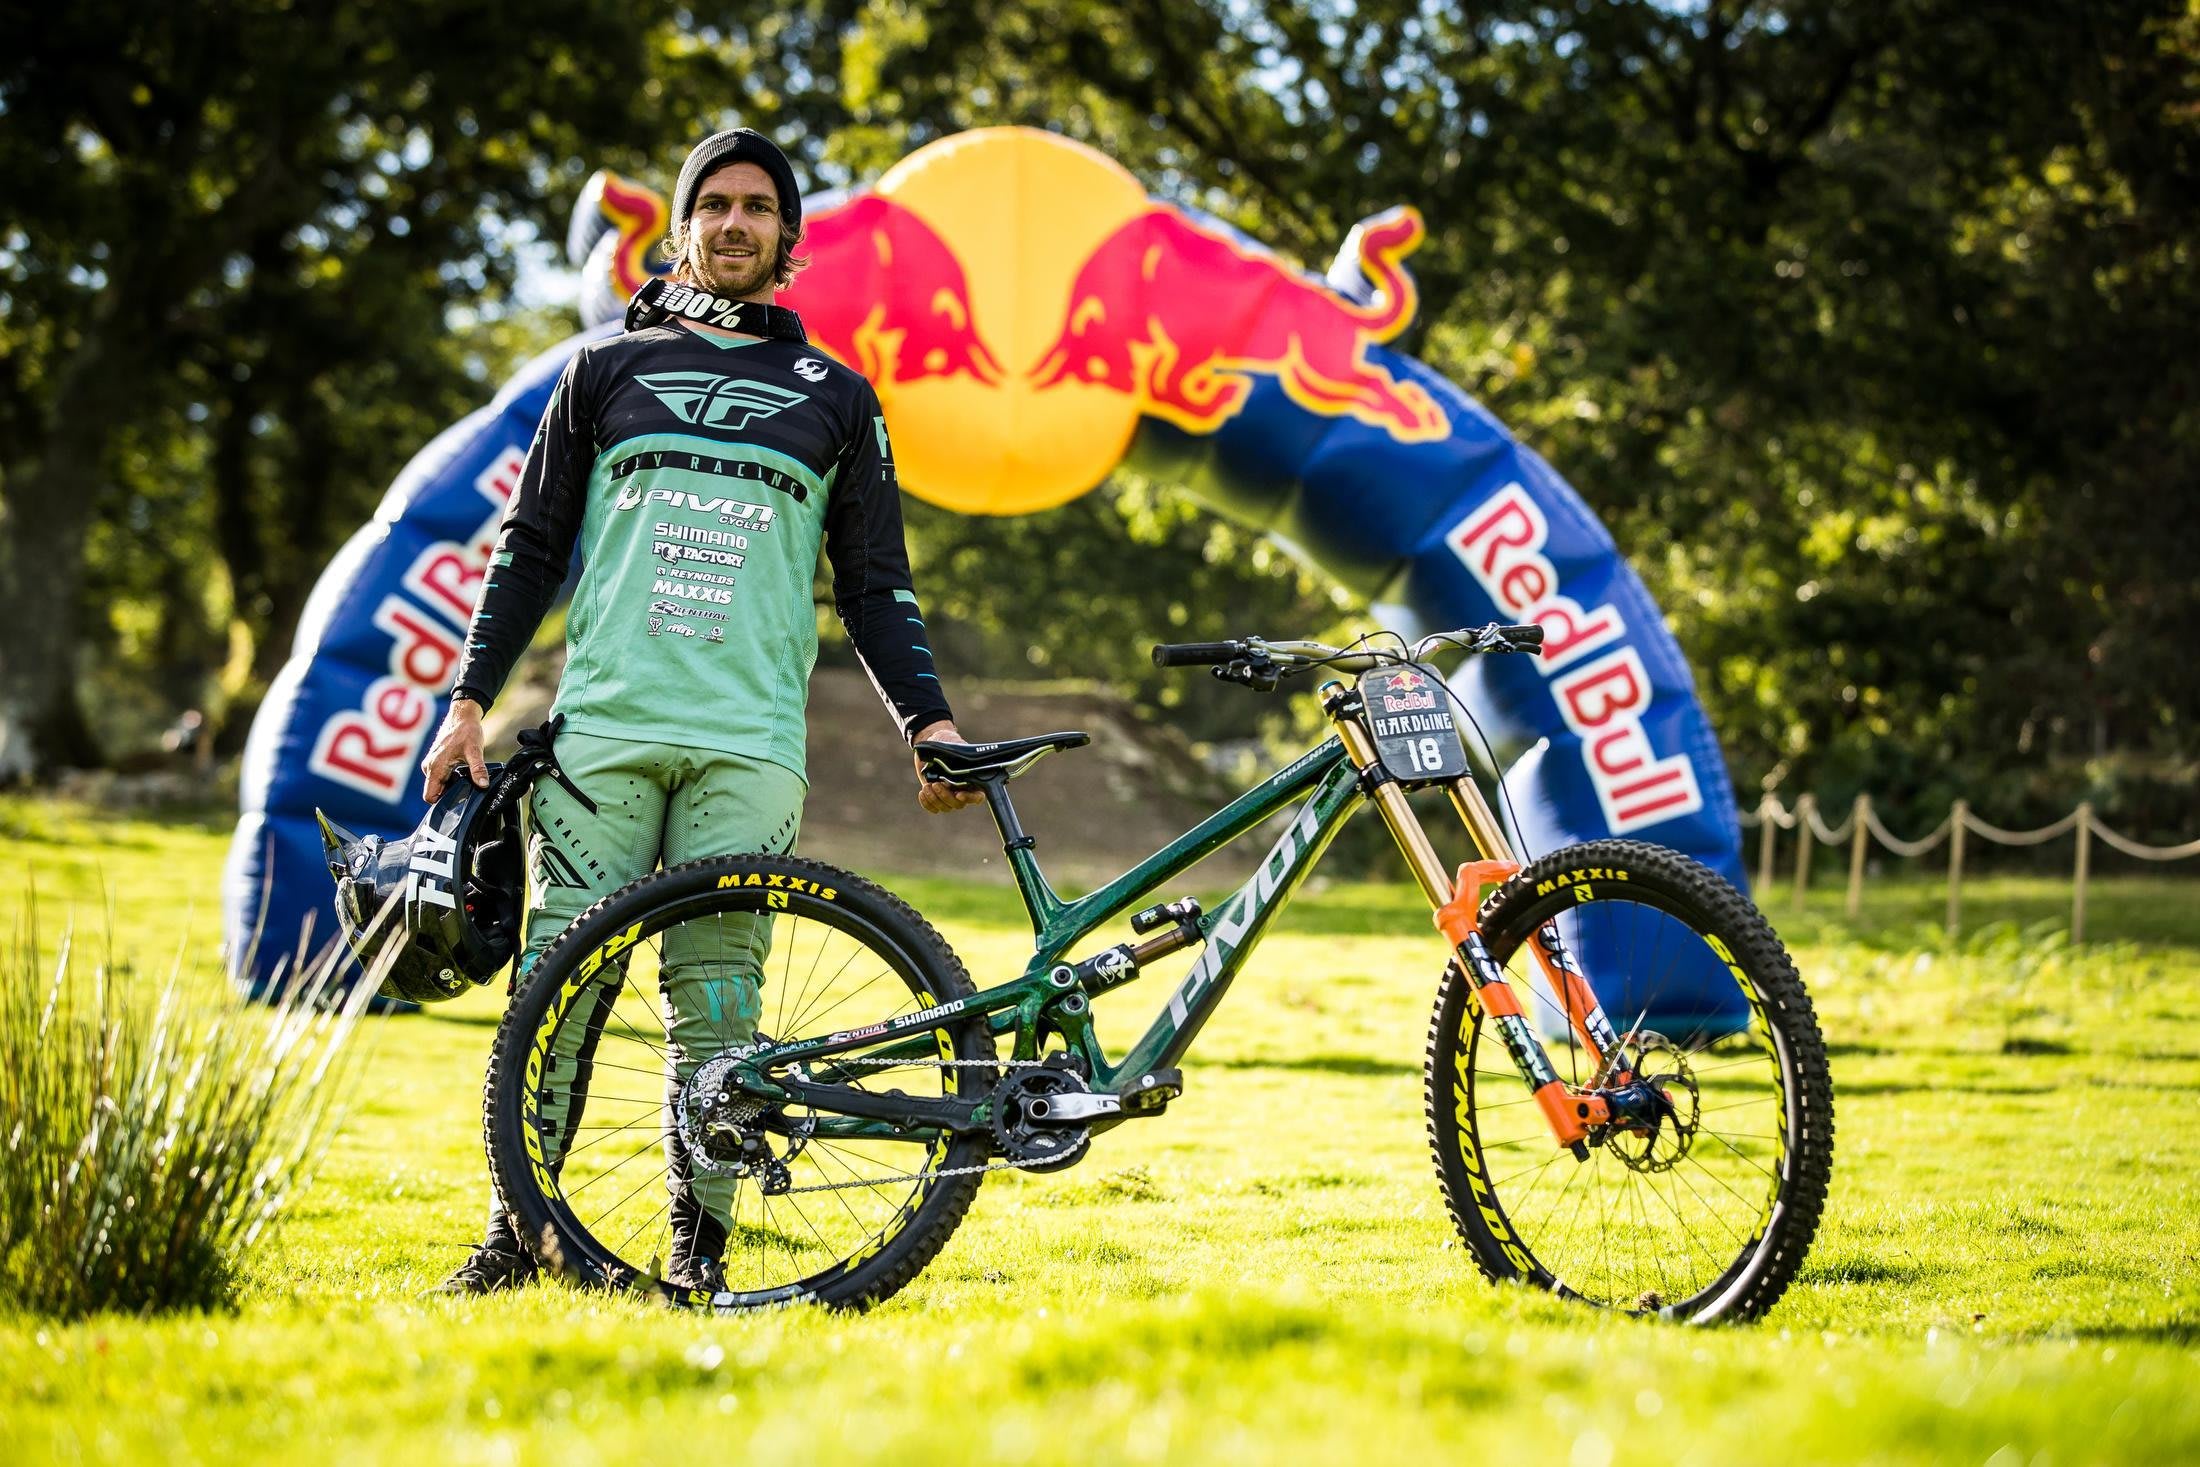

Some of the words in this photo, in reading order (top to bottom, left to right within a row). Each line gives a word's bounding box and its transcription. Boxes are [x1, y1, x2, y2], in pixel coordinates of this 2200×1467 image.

[653, 282, 744, 328] 100%
[620, 453, 662, 476] FLY
[690, 455, 797, 493] RACING
[643, 489, 776, 523] PIVOT
[655, 522, 748, 550] SHIMANO
[719, 516, 769, 532] CYCLES
[683, 547, 745, 568] FACTORY
[652, 580, 733, 605] MAXXIS
[670, 568, 735, 586] REYNOLDS
[1457, 494, 1614, 666] Red
[1561, 657, 1692, 826] Bull
[321, 608, 461, 791] Red
[1375, 713, 1453, 736] HARDLINE
[1407, 738, 1443, 772] 18
[534, 788, 549, 808] LY
[554, 817, 606, 881] RACING
[405, 824, 458, 910] FLY
[1536, 868, 1629, 896] MAXXIS
[717, 873, 838, 900] MAXXIS
[1169, 782, 1327, 1031] PIVOT
[894, 999, 965, 1029] SHIMANO
[521, 921, 643, 1201] REYNOLDS
[1454, 988, 1536, 1273] REYNOLDS
